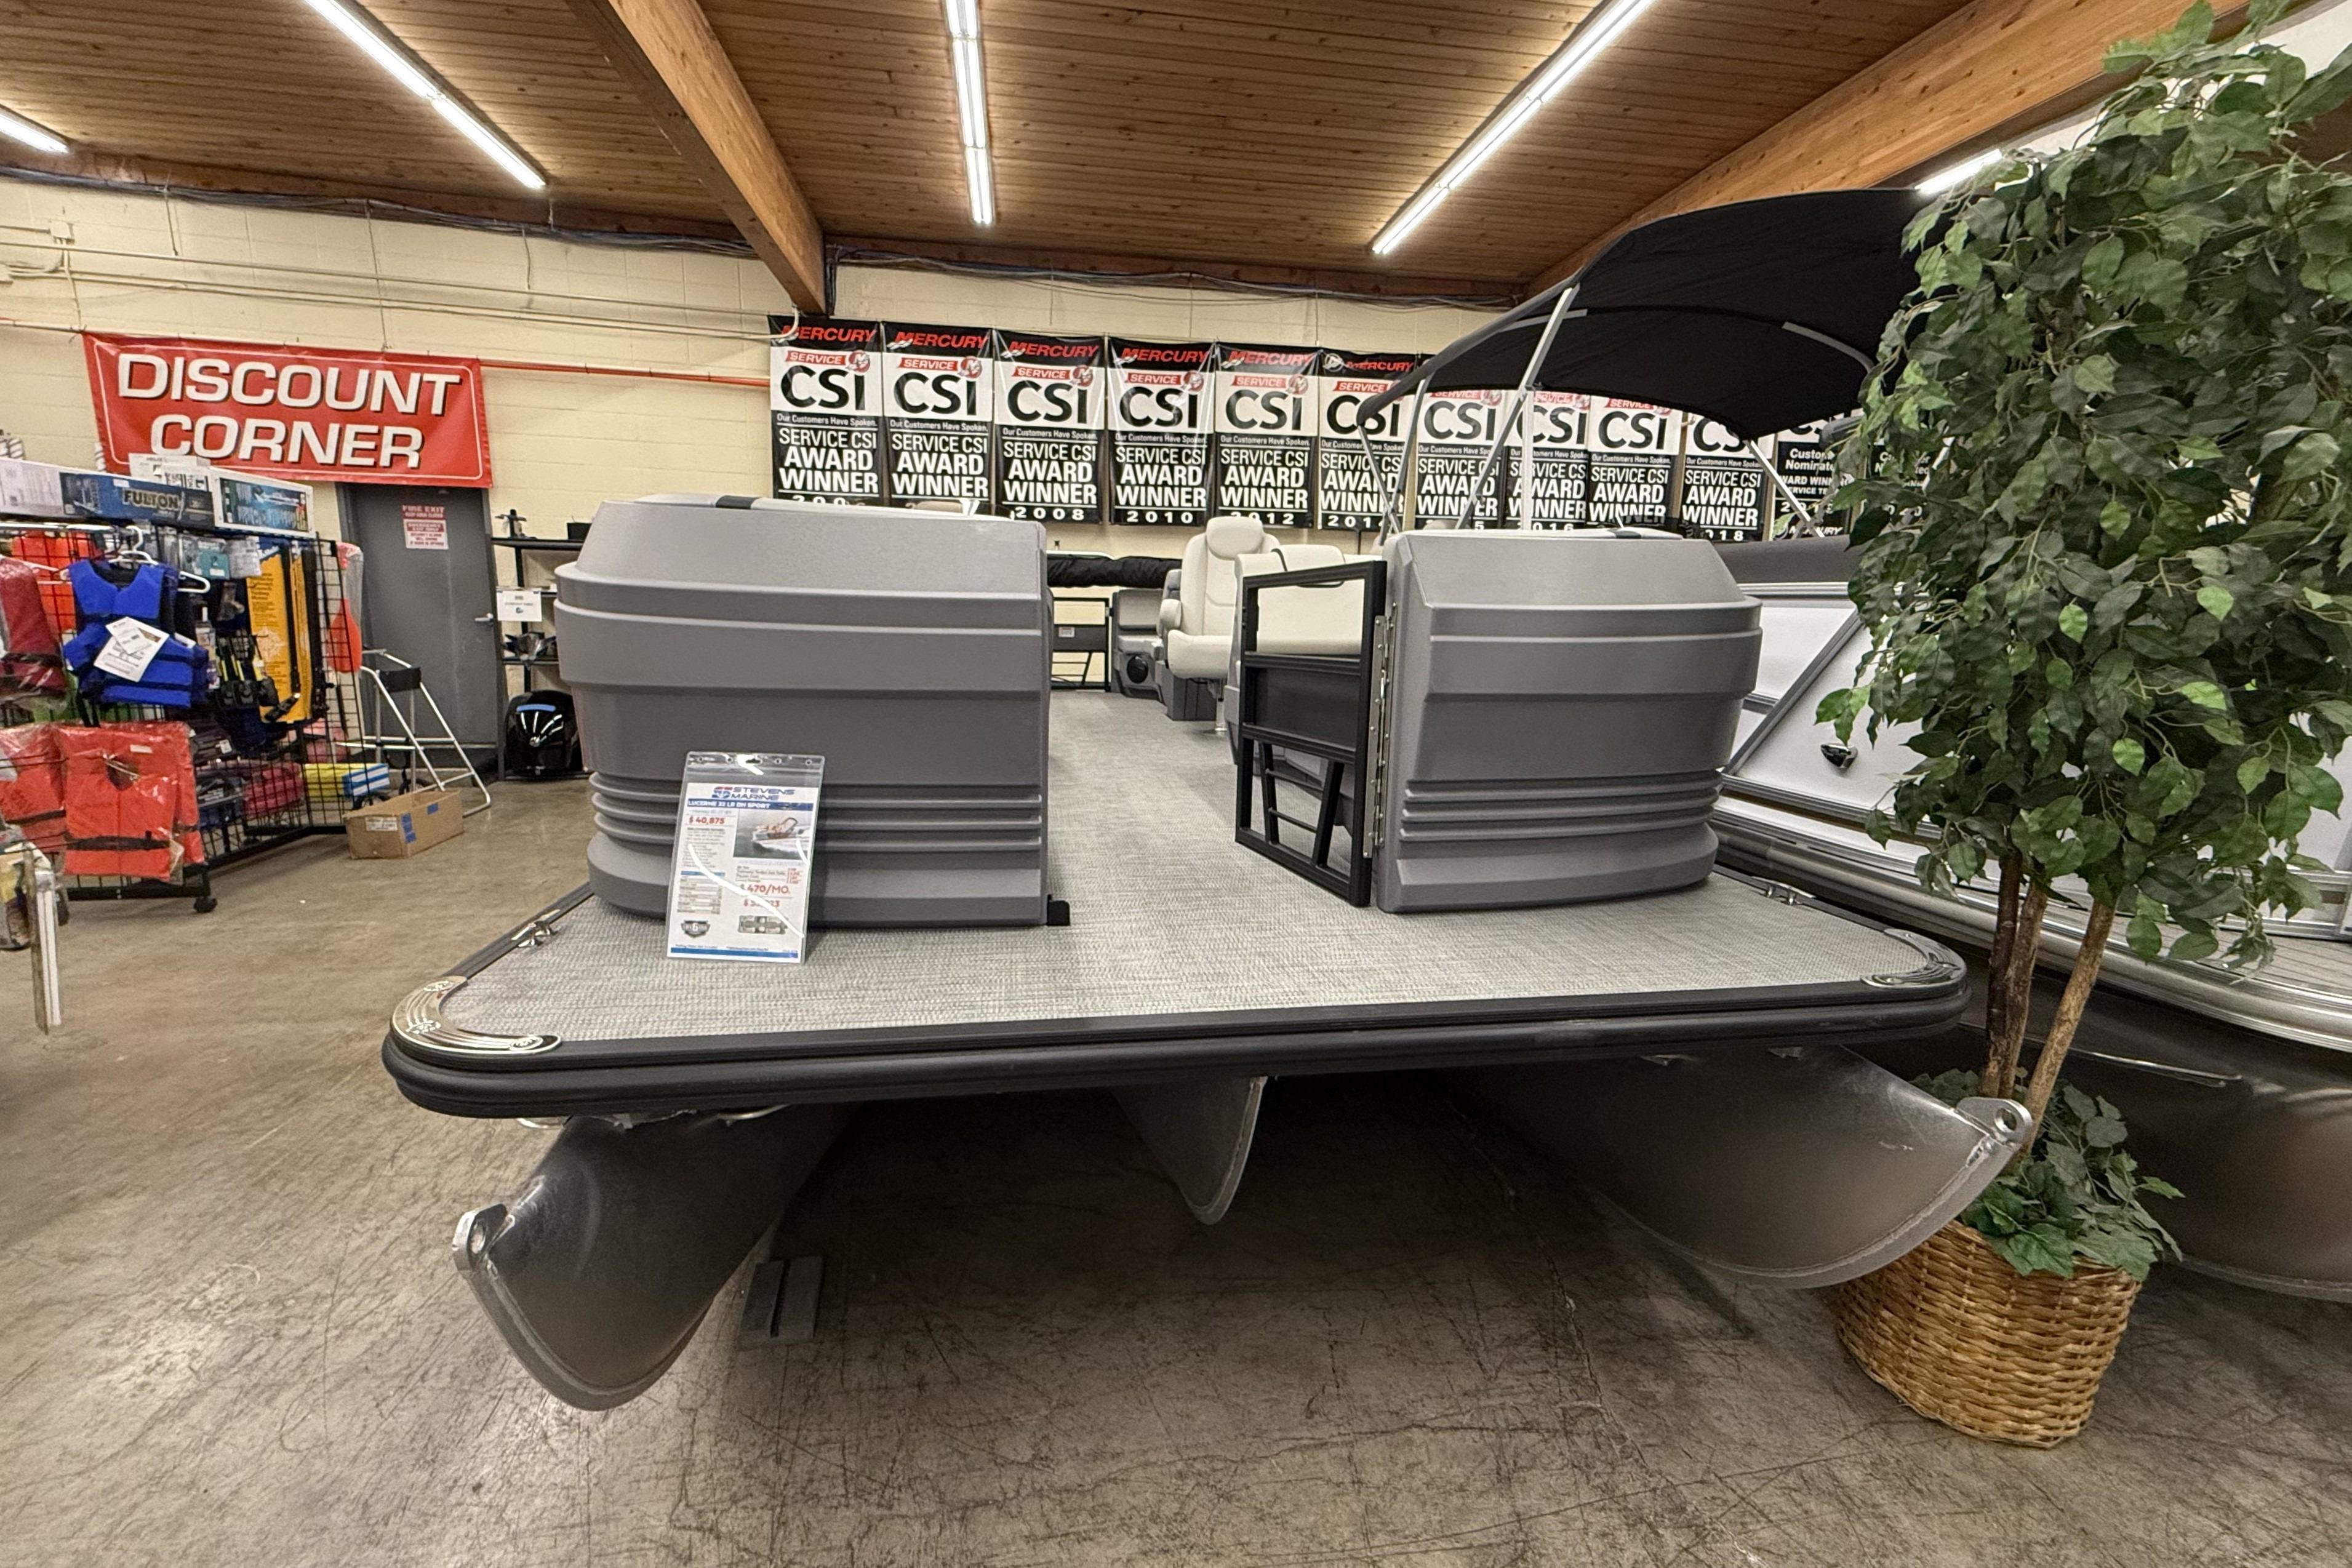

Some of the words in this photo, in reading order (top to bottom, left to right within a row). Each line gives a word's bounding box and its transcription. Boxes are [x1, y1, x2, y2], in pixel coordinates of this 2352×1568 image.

[895, 331, 988, 349] MERCURY
[790, 352, 842, 364] SERVICE
[1008, 341, 1099, 358] MERCURY
[1121, 347, 1210, 363] MERCURY
[904, 359, 954, 370] SERVICE
[1228, 351, 1316, 367] MERCURY
[1018, 367, 1067, 379] SERVICE
[1130, 374, 1178, 385] SERVICE
[118, 353, 460, 415] DISCOUNT
[781, 365, 865, 410] CSI
[1236, 377, 1284, 388] SERVICE
[1338, 382, 1385, 392] SERVICE
[894, 372, 977, 416] CSI
[1007, 380, 1087, 424] CSI
[1119, 386, 1198, 429] CSI
[1226, 389, 1303, 431] CSI
[1609, 399, 1651, 409] SERVICE
[777, 413, 790, 422] Our
[791, 414, 829, 425] Customers
[831, 417, 849, 426] Have
[850, 418, 878, 428] Spoken.
[904, 420, 941, 430] Customers
[942, 422, 960, 431] Have
[961, 423, 988, 433] Spoken.
[1424, 401, 1496, 441] CSI
[1516, 405, 1587, 444] CSI
[779, 428, 848, 448] SERVICE
[851, 432, 877, 449] CSI
[1002, 426, 1015, 436] Our
[1016, 428, 1052, 438] Customers
[1053, 430, 1070, 439] Have
[1071, 431, 1098, 440] Spoken.
[1115, 433, 1127, 442] Our
[1128, 433, 1163, 443] Customers
[1164, 434, 1181, 443] Have
[1598, 411, 1667, 450] CSI
[1694, 418, 1746, 452] CS
[151, 414, 423, 468] CORNER
[892, 433, 958, 453] SERVICE
[962, 437, 987, 454] CSI
[1220, 434, 1232, 444] Our
[1233, 435, 1267, 445] Customers
[1268, 436, 1284, 445] Have
[1286, 438, 1310, 447] Spoken.
[1321, 439, 1332, 448] Our
[1332, 440, 1365, 450] Customer
[1370, 442, 1382, 450] ave
[1383, 443, 1404, 452] Spoke
[784, 446, 873, 471] AWARD
[1003, 441, 1068, 460] SERVICE
[1071, 445, 1096, 462] CSI
[1116, 446, 1178, 464] SERVICE
[1182, 449, 1206, 465] CSI
[1221, 448, 1282, 466] SERVICE
[1285, 450, 1308, 467] CSI
[1430, 446, 1462, 454] Customers
[1463, 447, 1478, 455] Have
[1554, 450, 1569, 458] Have
[1592, 454, 1602, 462] Our
[1602, 454, 1633, 463] Customers
[897, 451, 983, 476] AWARD
[1008, 459, 1092, 482] AWARD
[1321, 453, 1380, 471] SERVIC
[1382, 456, 1402, 472] CS
[1418, 458, 1476, 475] SERVICE
[1569, 463, 1586, 479] CS
[1686, 457, 1696, 465] Our
[1697, 458, 1727, 466] Customers
[1728, 459, 1742, 467] Have
[1785, 459, 1834, 471] Nominate
[779, 468, 878, 493] WINNER
[1120, 463, 1201, 486] AWARD
[1225, 465, 1305, 488] AWARD
[1591, 466, 1646, 483] SERVICE
[1647, 469, 1669, 484] CSI
[1685, 470, 1739, 486] SERVICE
[1740, 472, 1761, 487] CSI
[1780, 475, 1808, 485] WARD
[892, 473, 988, 497] WINNER
[1003, 480, 1097, 505] WINNER
[1593, 482, 1664, 503] AWARD
[1790, 486, 1817, 495] RVICE
[124, 489, 179, 510] FULTON
[1116, 485, 1206, 507] WINNER
[1220, 486, 1308, 509] WINNER
[1686, 486, 1756, 506] AWARD
[1015, 506, 1085, 521] 2008
[1127, 511, 1193, 523] 2010
[1327, 515, 1383, 528] 201
[1589, 502, 1666, 523] WINNER
[1682, 505, 1758, 527] WINNER
[733, 786, 796, 795] STEVENS
[695, 817, 725, 825] 40,875
[747, 884, 791, 895] 470/MO.
